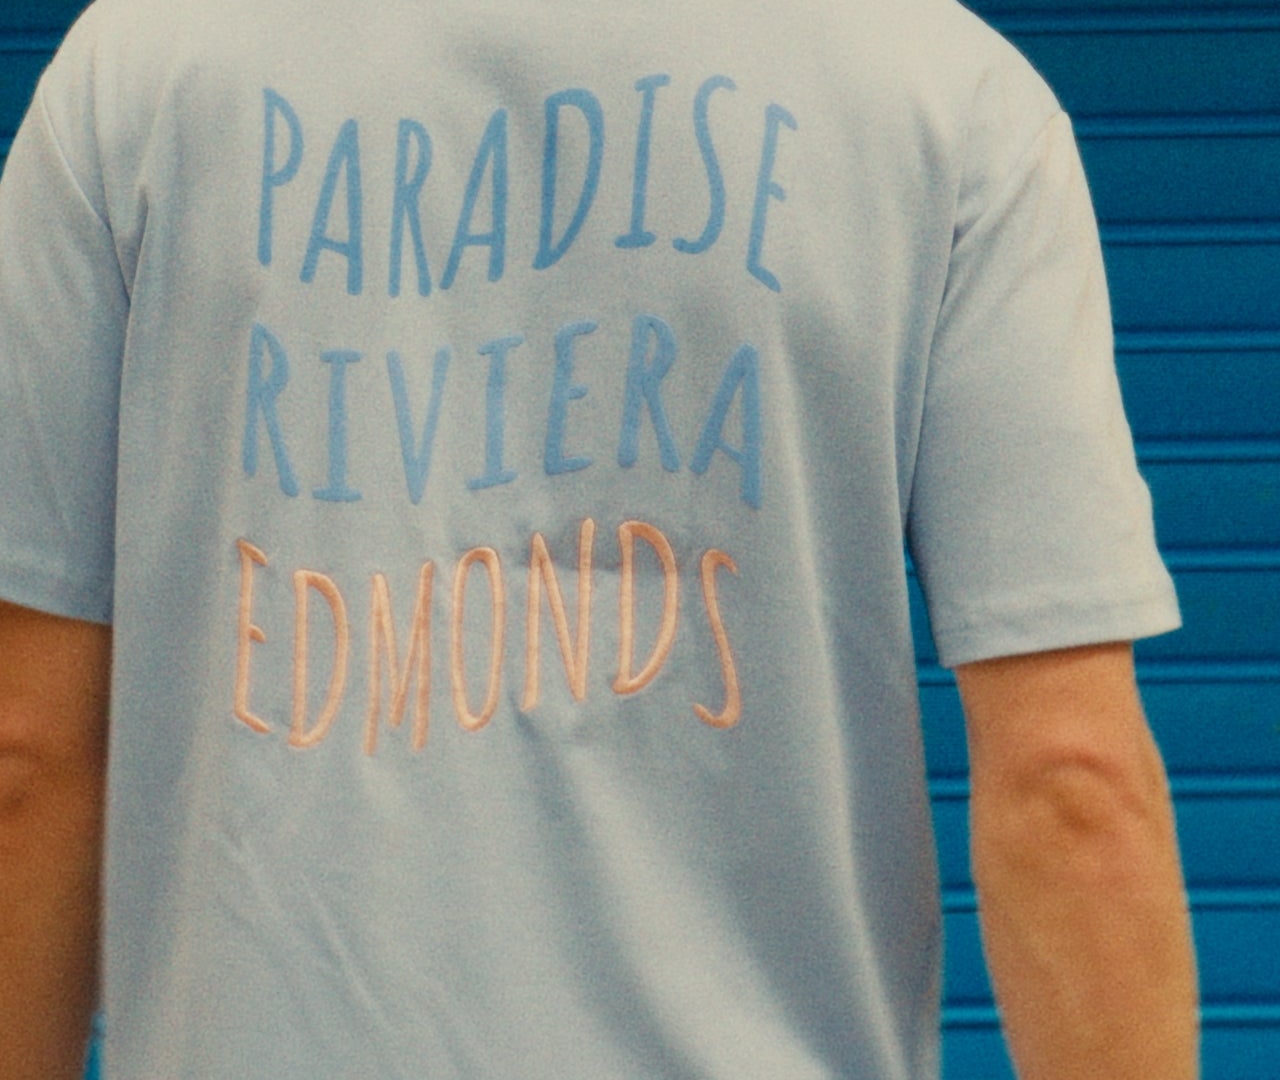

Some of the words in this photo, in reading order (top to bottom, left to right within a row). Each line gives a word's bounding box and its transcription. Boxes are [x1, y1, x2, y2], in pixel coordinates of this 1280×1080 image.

[257, 74, 798, 295] PARADISE
[241, 314, 763, 510] RIVIERA
[233, 518, 742, 756] EDMONDS
